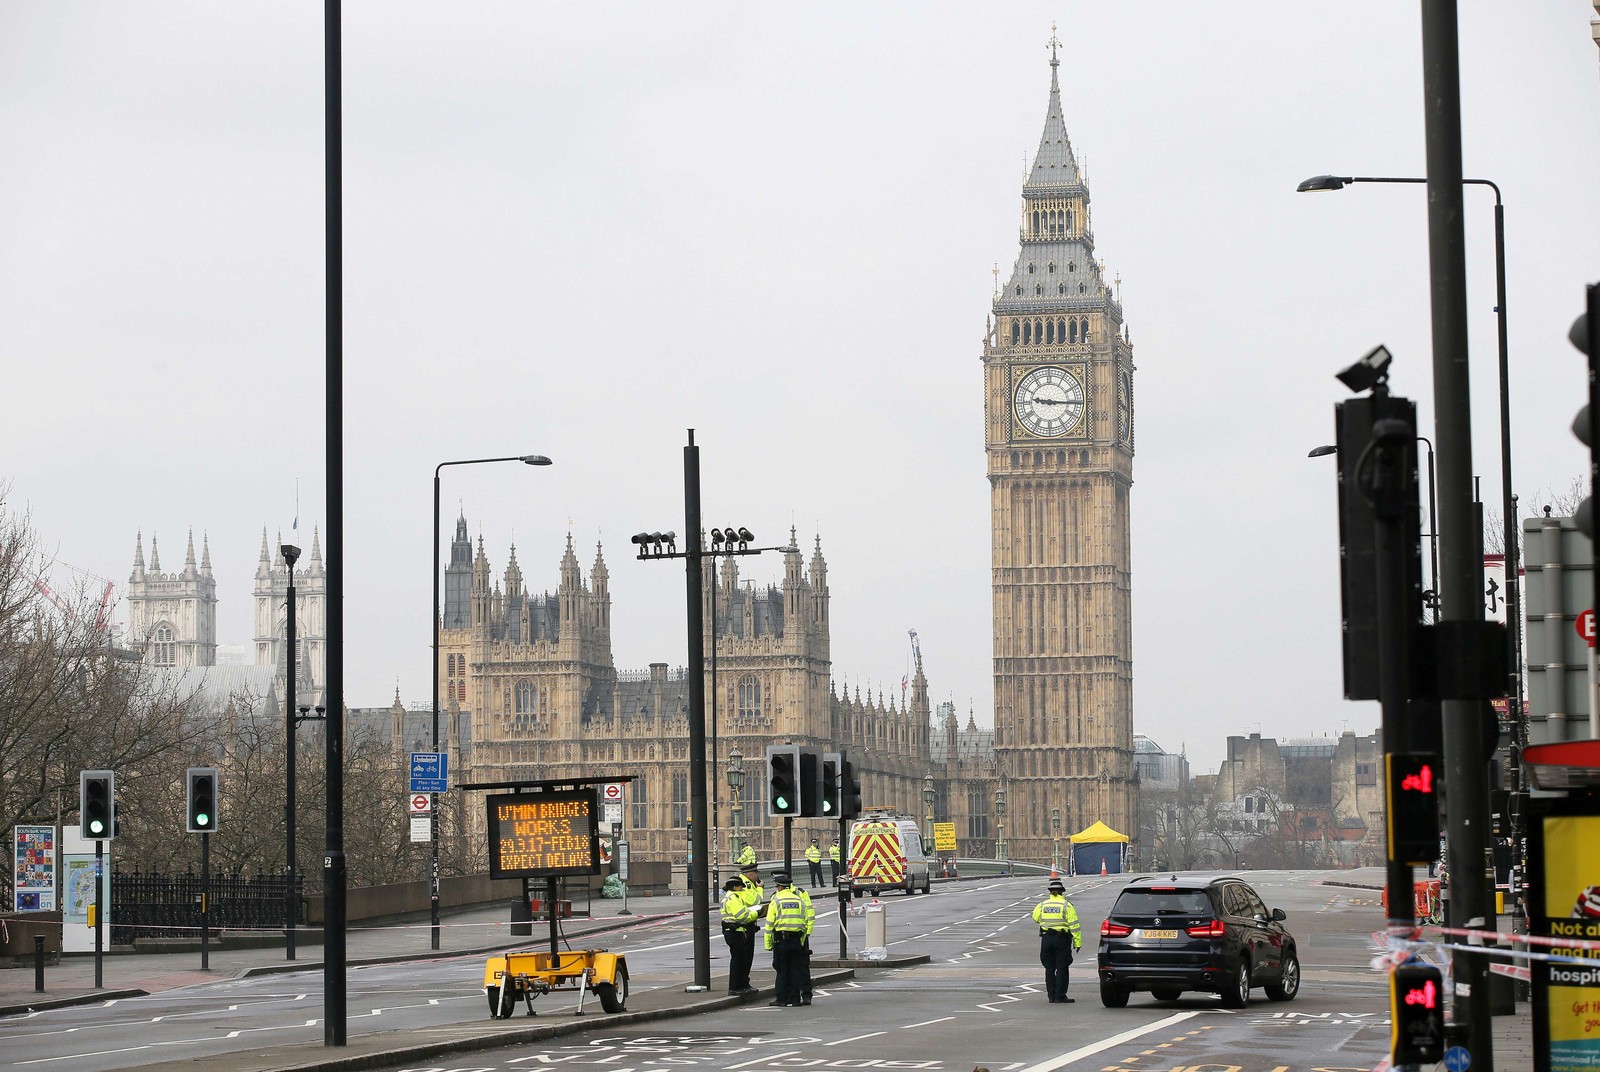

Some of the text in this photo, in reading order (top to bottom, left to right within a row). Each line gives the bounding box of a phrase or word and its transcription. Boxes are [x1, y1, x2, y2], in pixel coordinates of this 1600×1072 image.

[540, 801, 589, 819] BRIDGES
[515, 819, 571, 837] WORKS
[500, 851, 592, 871] EXPECT DELAYS
[1551, 922, 1583, 936] Not
